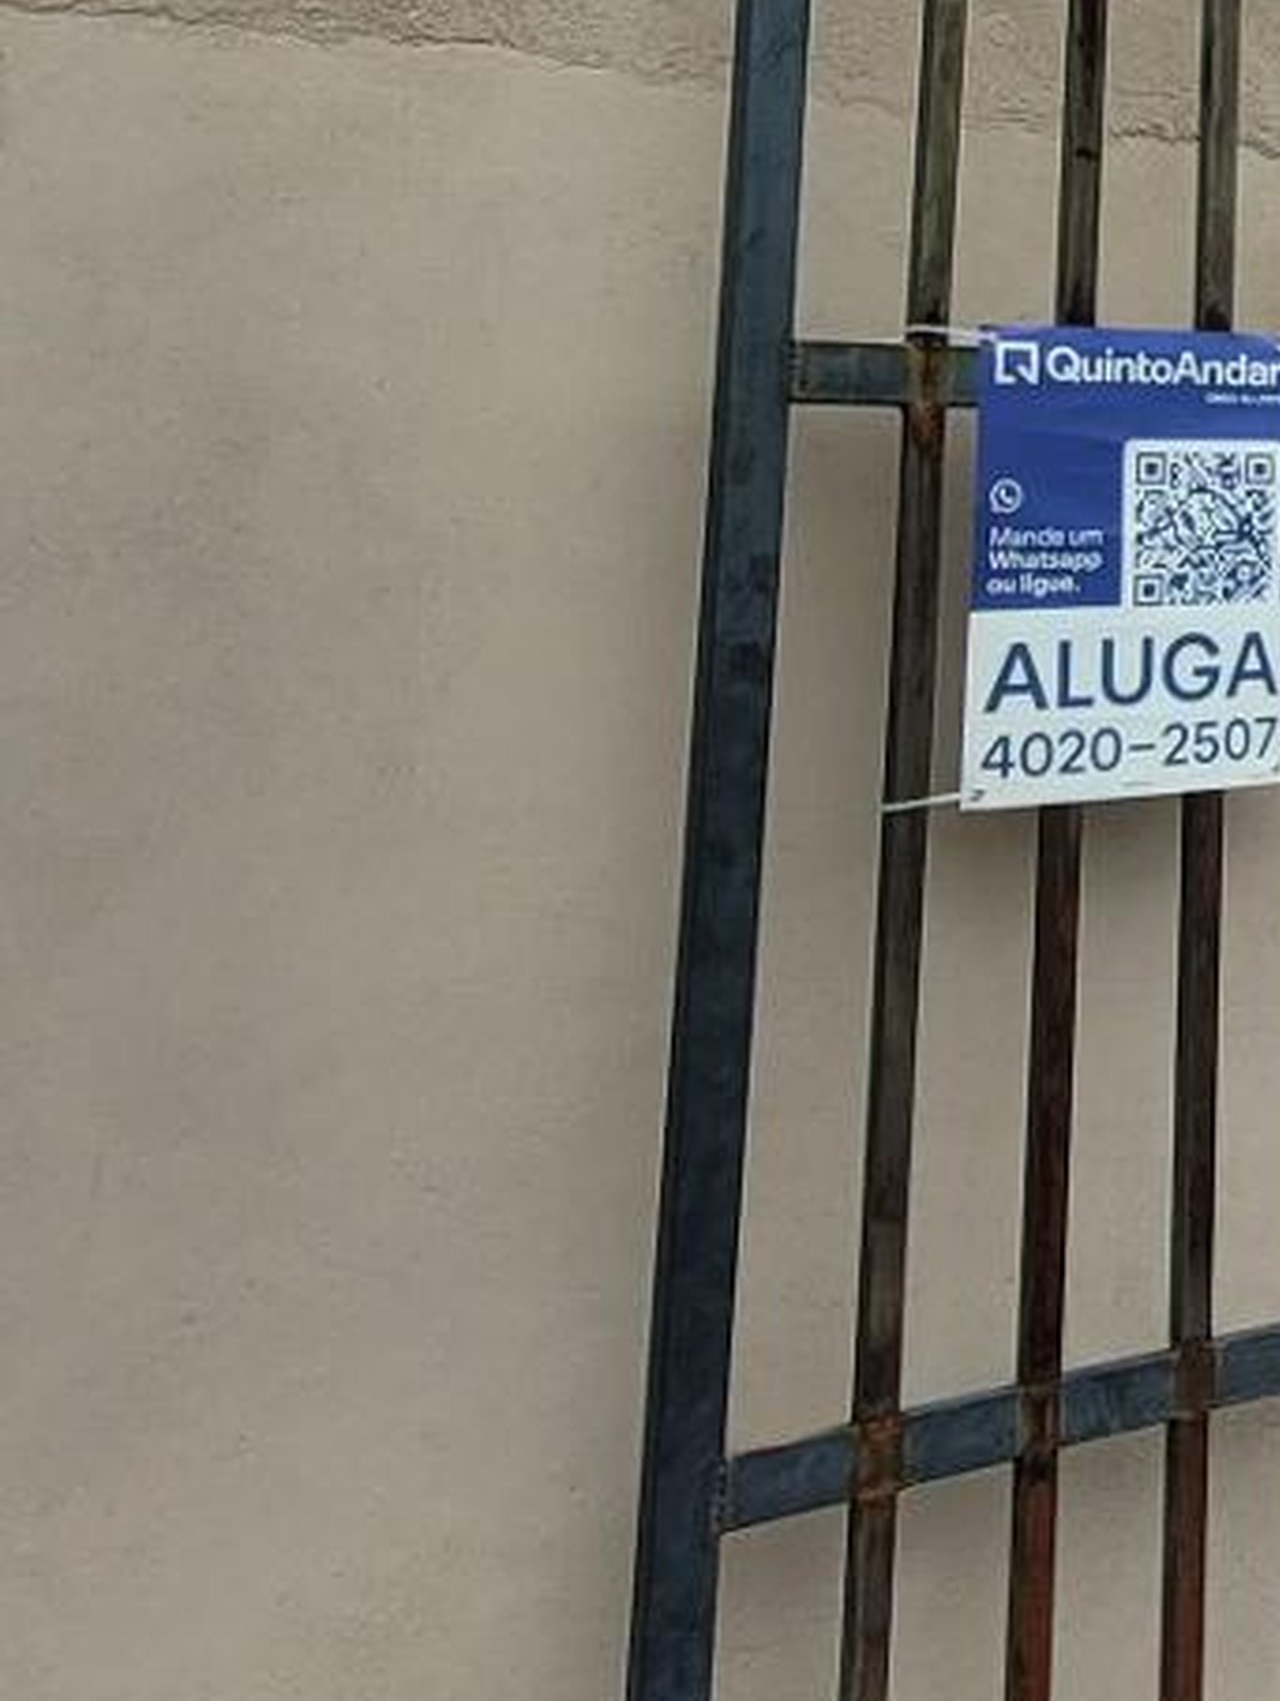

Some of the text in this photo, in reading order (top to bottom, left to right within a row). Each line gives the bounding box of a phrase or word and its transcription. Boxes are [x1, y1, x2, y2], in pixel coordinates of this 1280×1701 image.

[989, 527, 1104, 547] Mande um
[985, 577, 1017, 595] ou
[983, 631, 1279, 713] ALUGA
[981, 717, 1279, 779] 4020-2507
